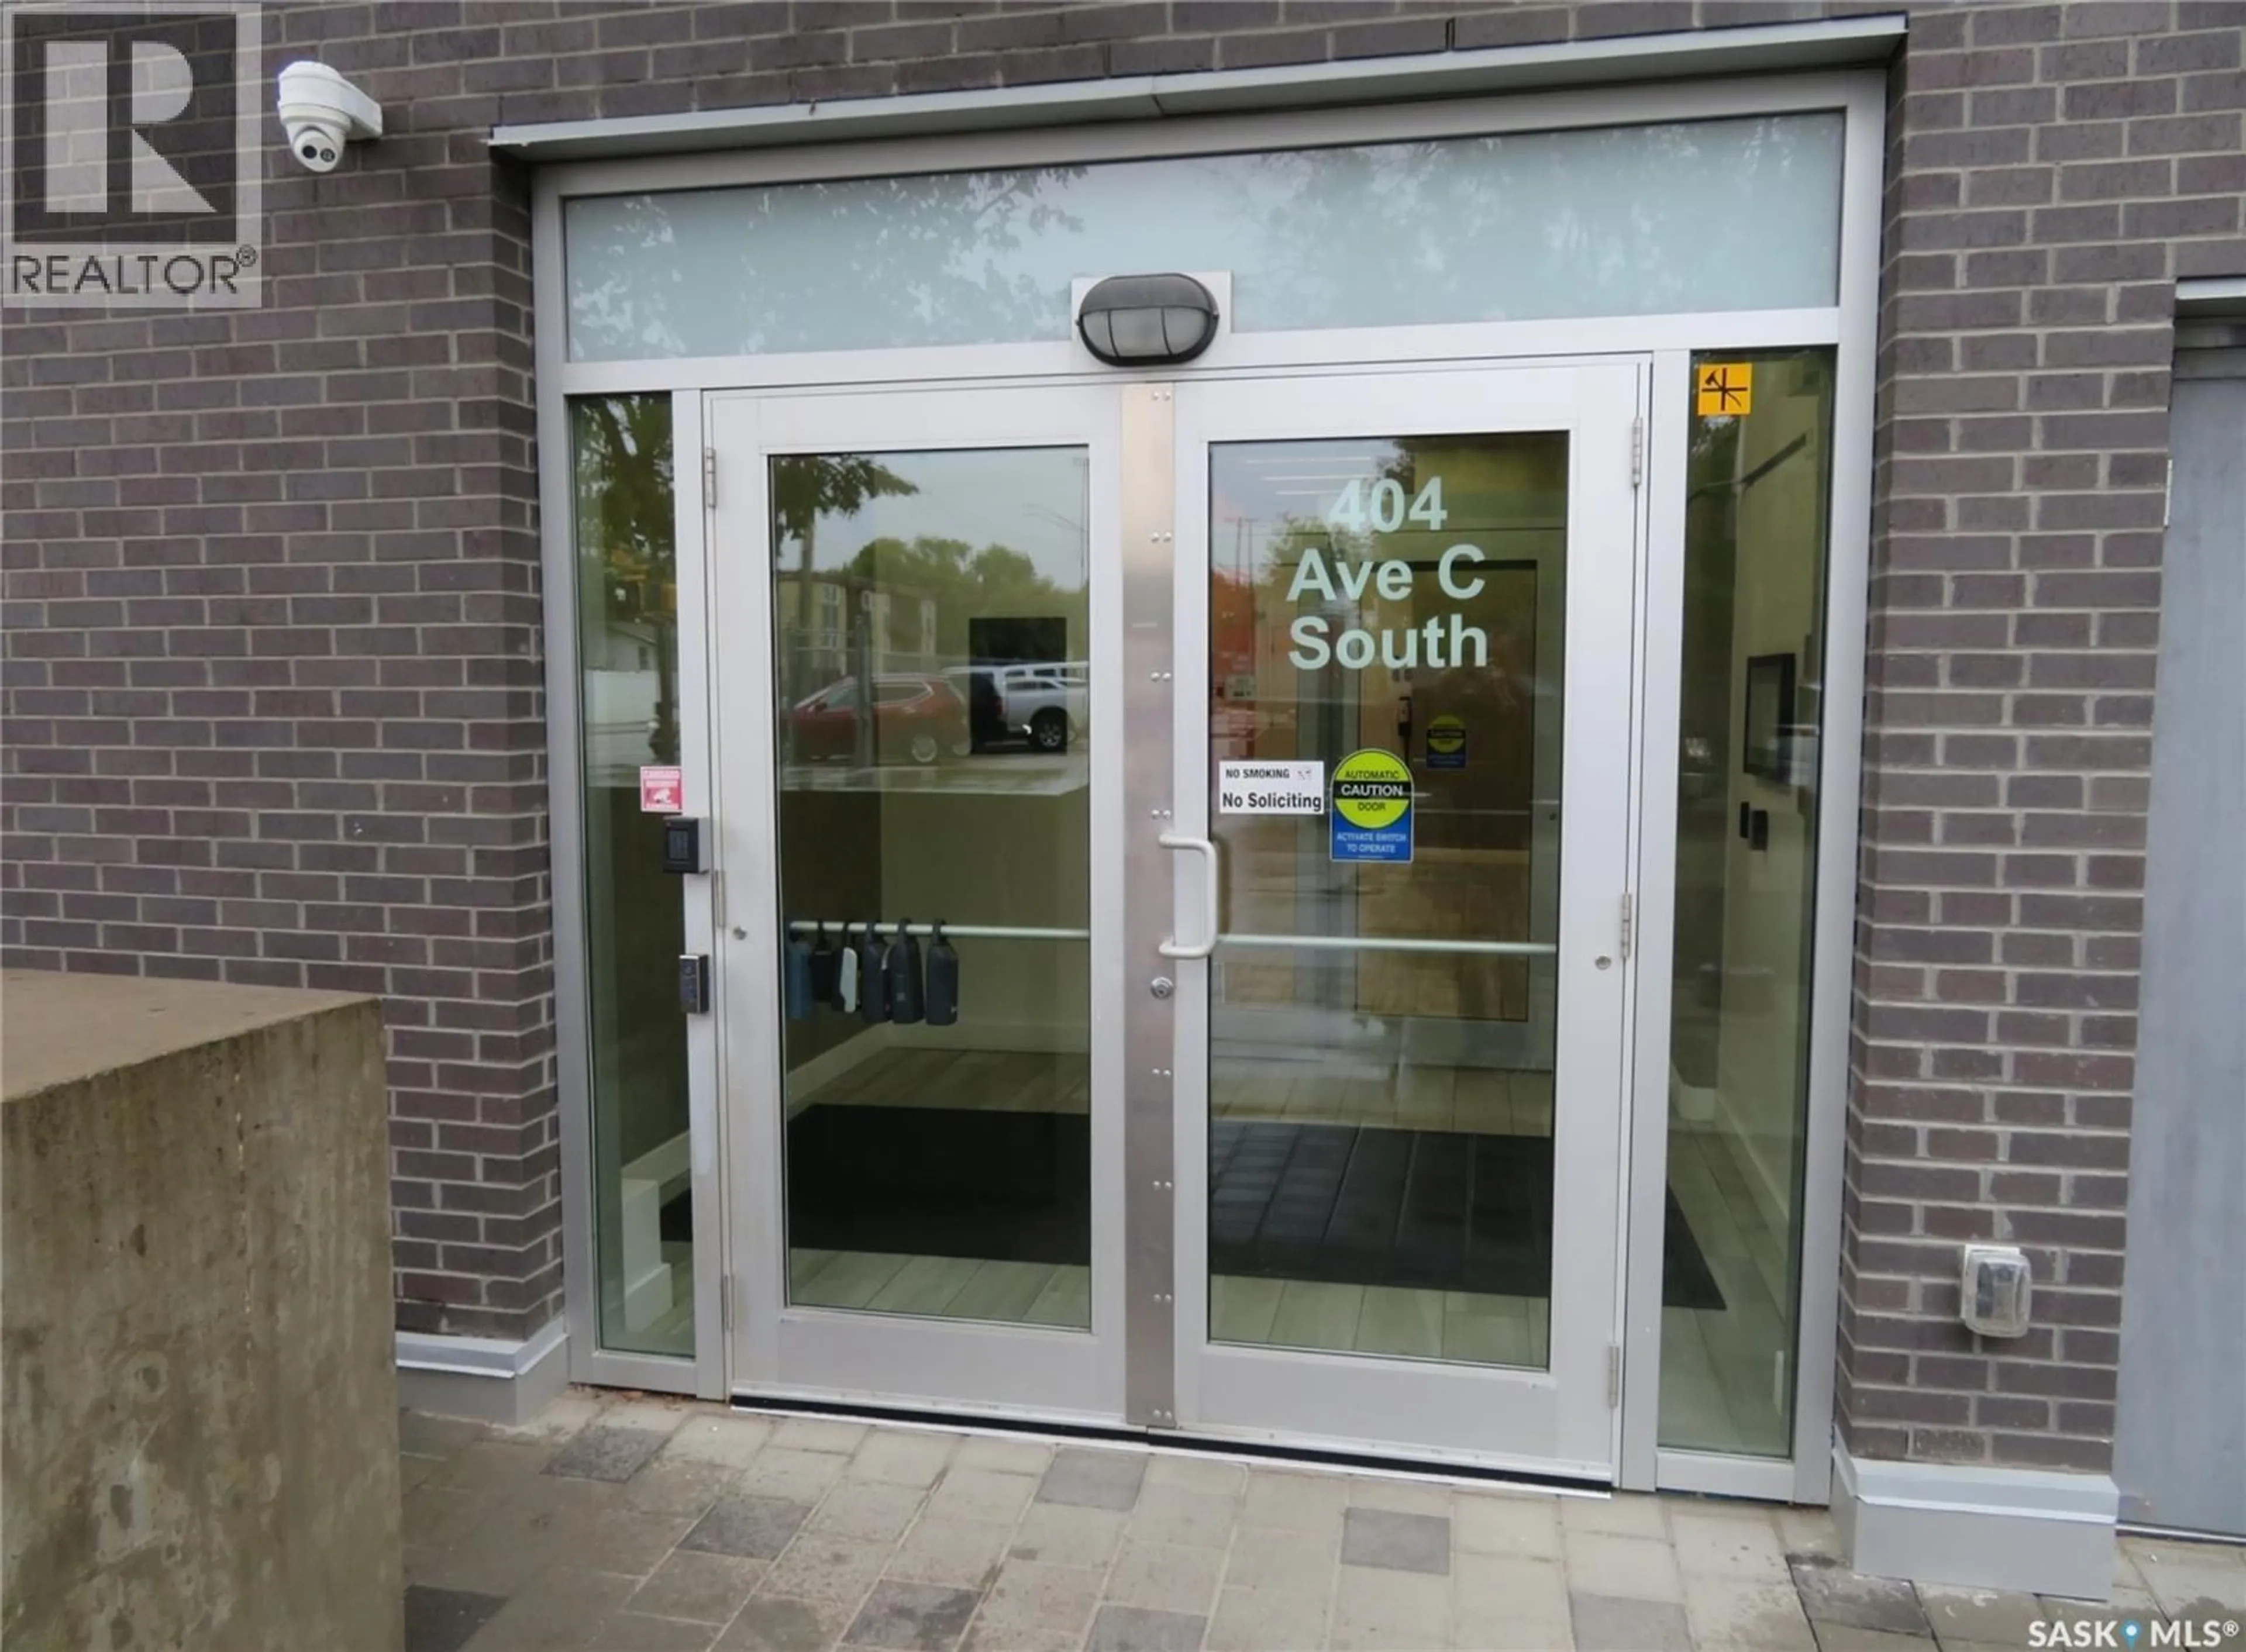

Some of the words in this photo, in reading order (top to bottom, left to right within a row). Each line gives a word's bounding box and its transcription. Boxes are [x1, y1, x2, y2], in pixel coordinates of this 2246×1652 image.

[1329, 476, 1448, 533] 404
[1286, 547, 1414, 602] Ave
[1438, 544, 1486, 600] C
[1288, 613, 1488, 671] South
[1225, 768, 1240, 778] NO
[1243, 768, 1290, 779] SMOKING
[1345, 770, 1400, 780] AUTOMATIC
[1341, 784, 1403, 796] CAUTION
[1222, 792, 1243, 808] No
[1248, 792, 1322, 812] Soliciting
[1357, 801, 1386, 811] DOOR
[1346, 843, 1358, 853] TO
[1359, 844, 1396, 853] OPERATE
